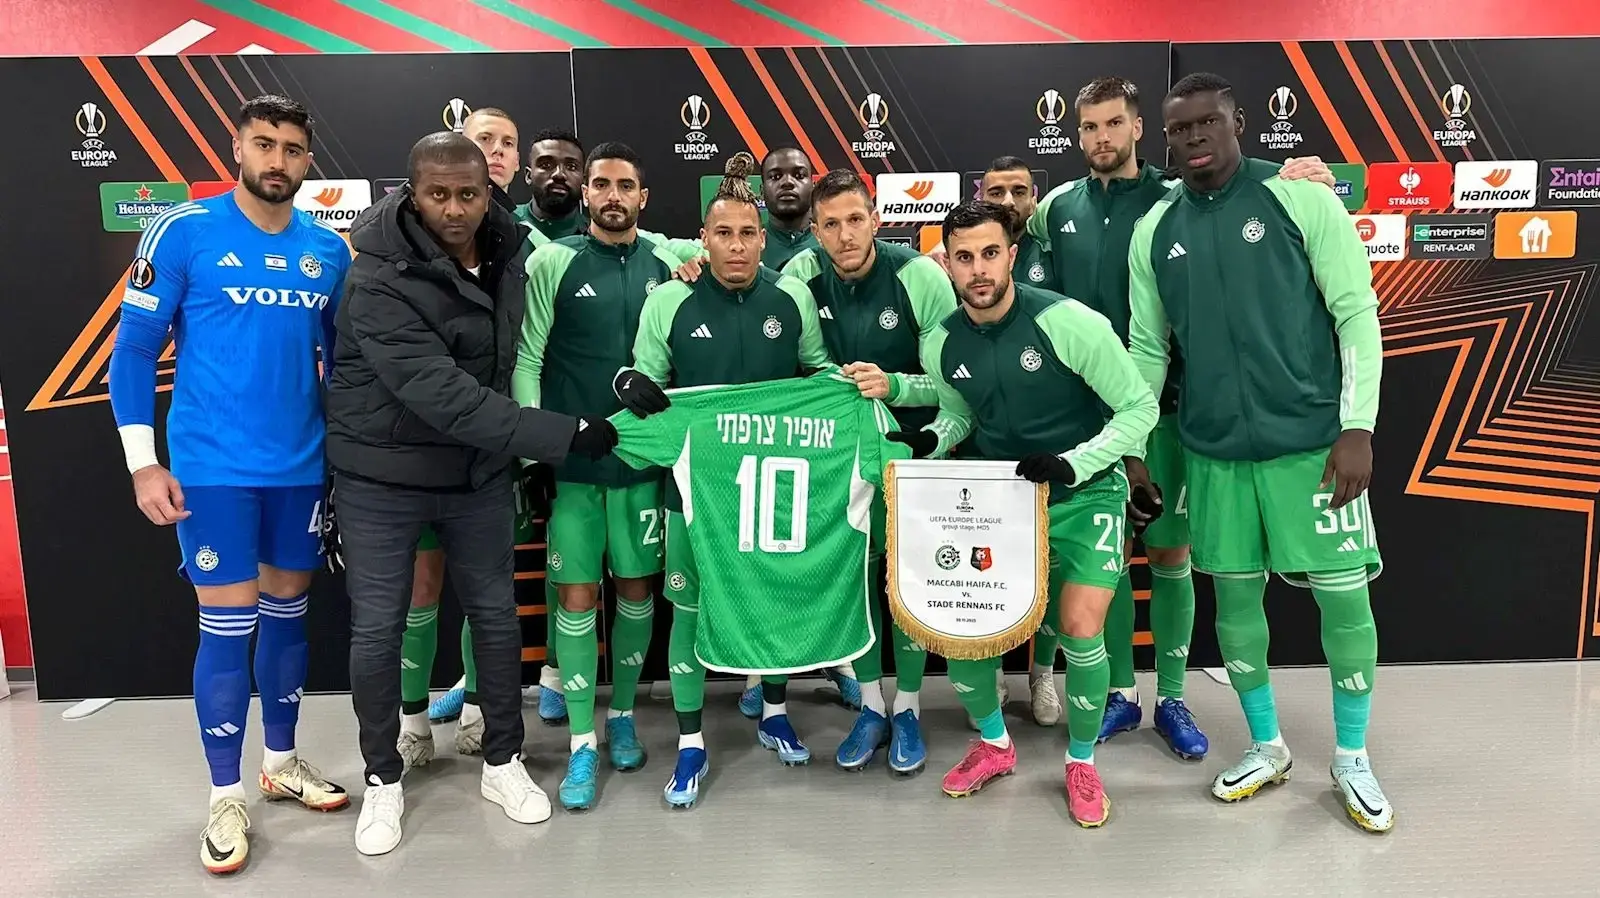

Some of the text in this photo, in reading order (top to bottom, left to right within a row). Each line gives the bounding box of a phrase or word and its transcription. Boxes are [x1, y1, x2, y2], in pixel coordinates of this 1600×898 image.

[1271, 123, 1291, 131] UEFA
[1260, 133, 1303, 143] EUROPA
[1433, 130, 1476, 140] EUROPA
[82, 140, 103, 149] UEFA
[852, 141, 896, 151] EUROPA
[1028, 137, 1072, 148] EUROPA
[674, 143, 719, 153] EUROPA
[71, 150, 118, 160] EUROPA
[1388, 197, 1430, 206] STRAUSS
[1420, 227, 1485, 238] enterprise
[1423, 243, 1476, 253] RENT-A-CAR
[221, 286, 330, 311] VOLVO
[716, 413, 836, 449] אופיר צרפתי
[735, 454, 810, 553] 10
[1312, 493, 1361, 534] 30
[948, 516, 974, 524] EUROPE
[976, 517, 1002, 525] LEAGUE
[1093, 513, 1122, 554] 21
[926, 579, 964, 587] MACCABI
[966, 580, 992, 588] HAIFA
[927, 600, 1006, 611] STADE RENNAIS FC
